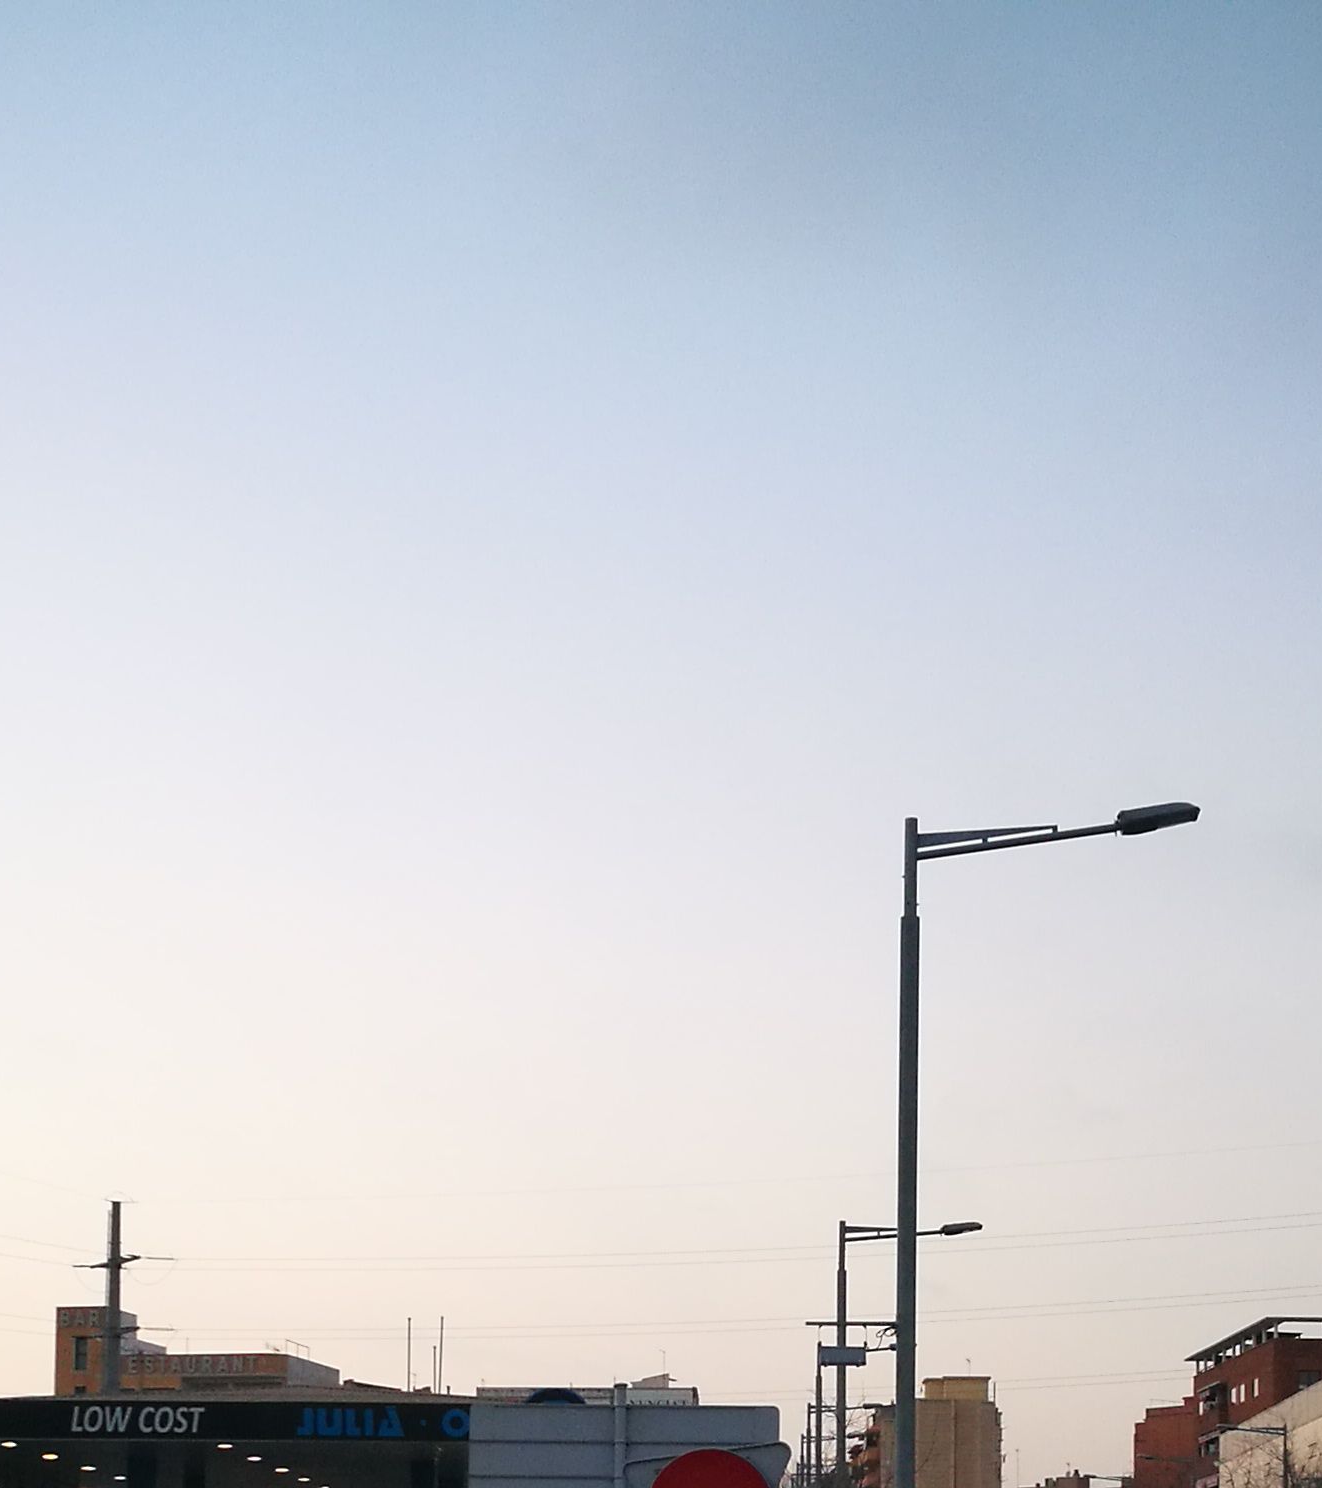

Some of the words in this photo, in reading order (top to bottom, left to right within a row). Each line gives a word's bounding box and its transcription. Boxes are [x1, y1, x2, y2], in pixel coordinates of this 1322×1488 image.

[61, 1311, 100, 1327] BAR
[127, 1356, 257, 1374] ESTAURANT
[71, 1405, 132, 1433] LOW
[138, 1406, 205, 1433] COST
